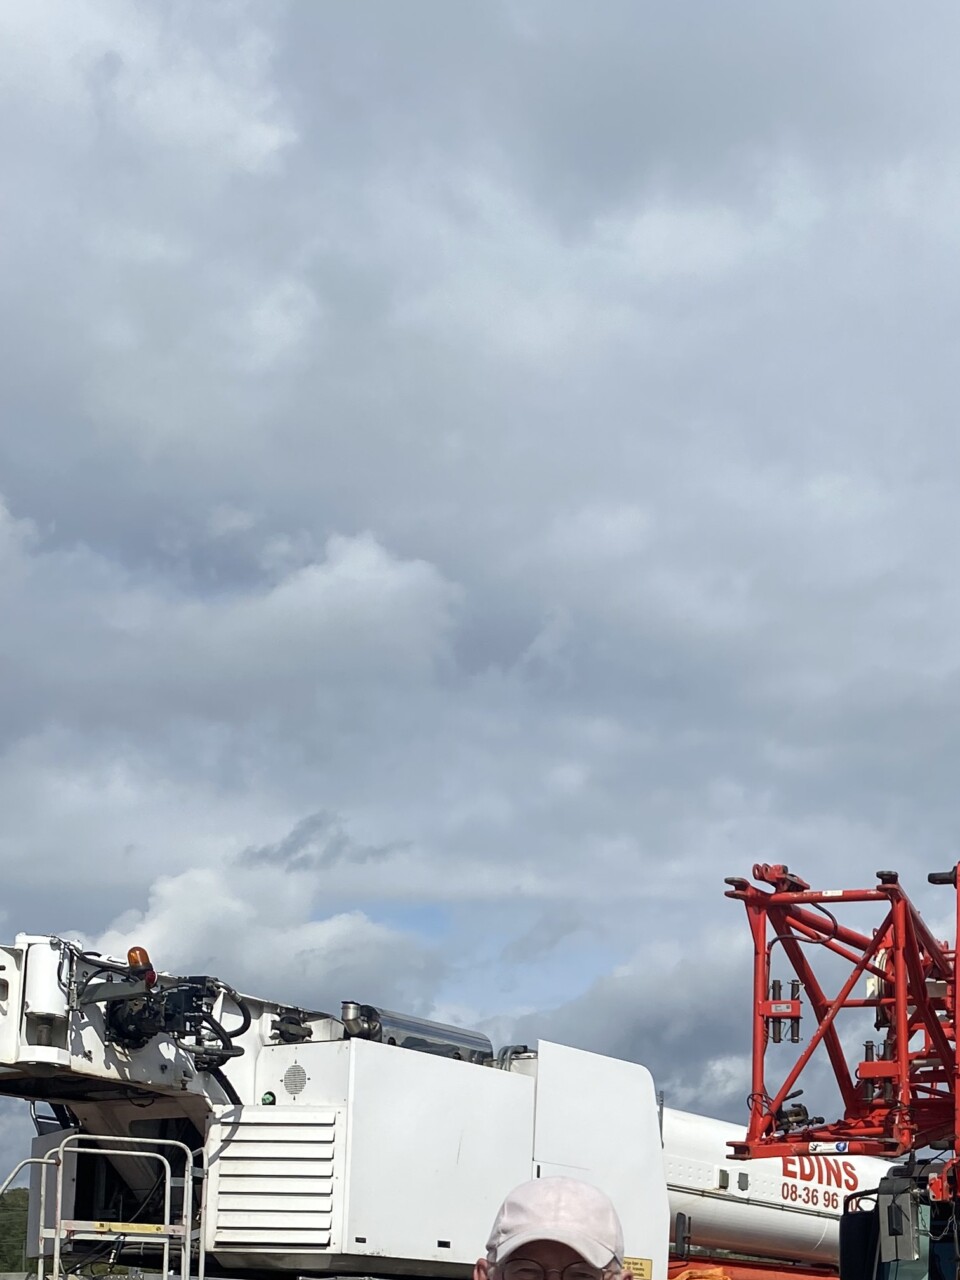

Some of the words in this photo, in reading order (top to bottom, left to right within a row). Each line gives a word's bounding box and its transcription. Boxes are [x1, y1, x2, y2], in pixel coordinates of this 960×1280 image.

[782, 1155, 858, 1191] EDINS
[782, 1182, 819, 1206] 08-36
[823, 1191, 839, 1209] 96
